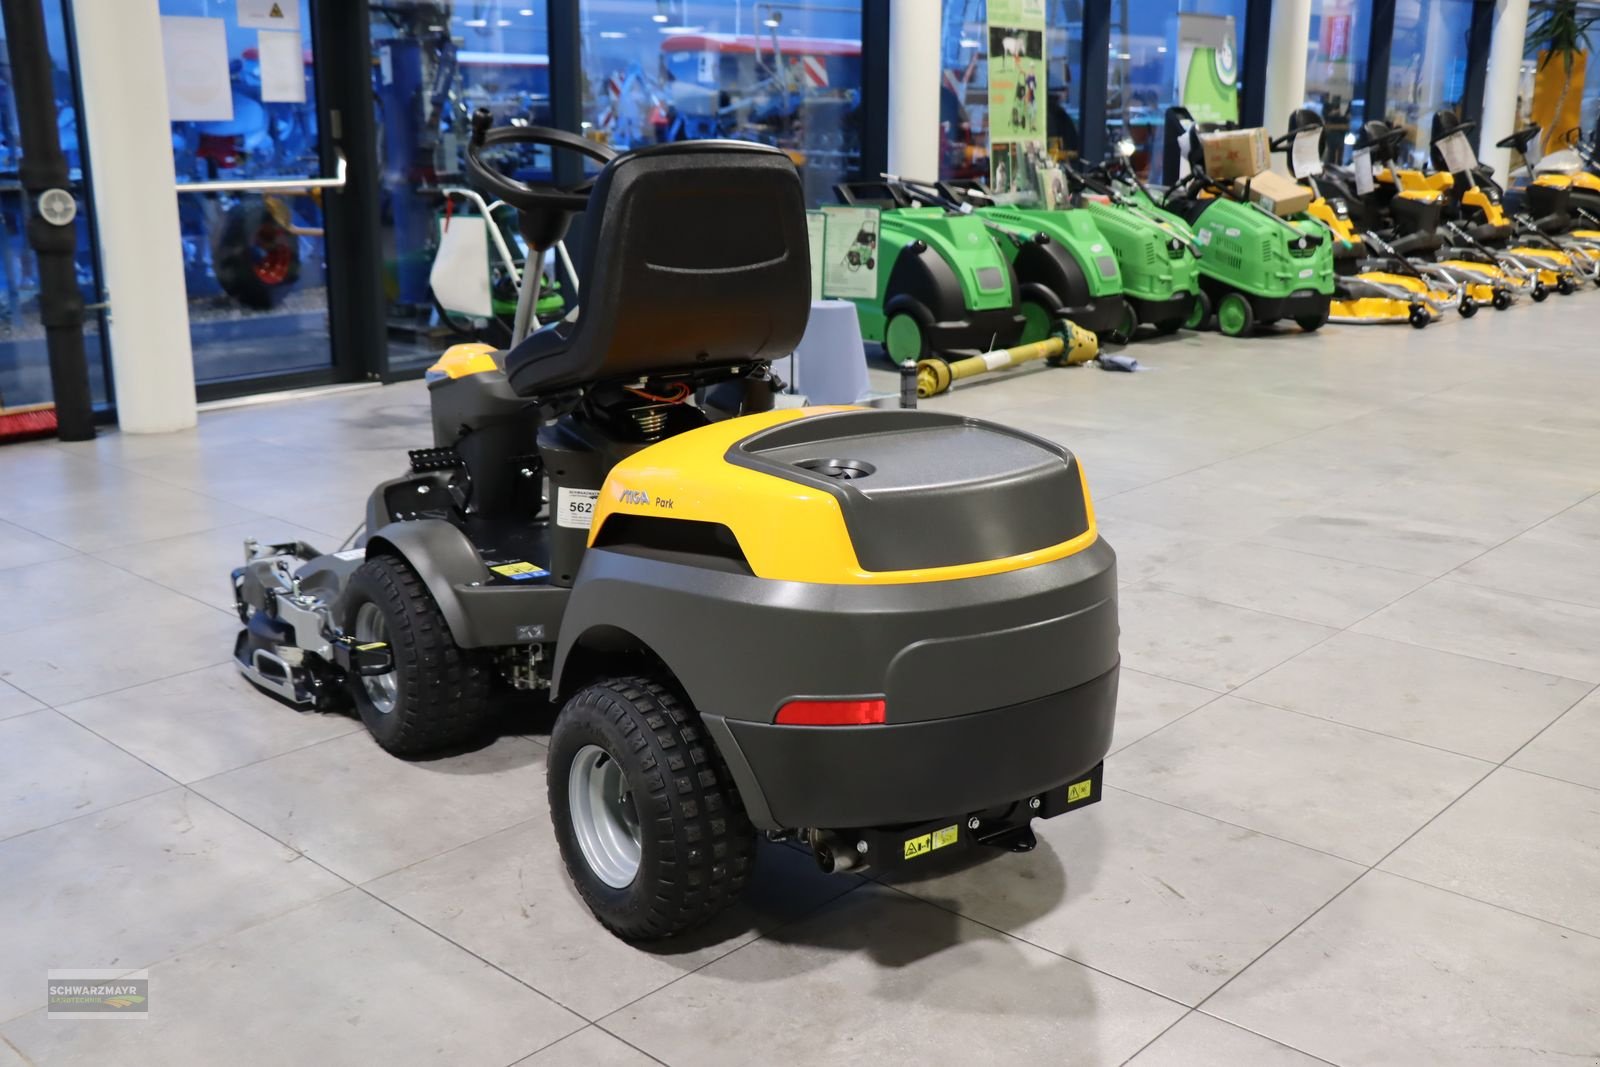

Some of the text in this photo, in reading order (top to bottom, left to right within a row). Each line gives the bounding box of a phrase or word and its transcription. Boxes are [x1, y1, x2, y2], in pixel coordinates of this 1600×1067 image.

[619, 489, 674, 509] STIGA Park
[569, 502, 594, 512] 562
